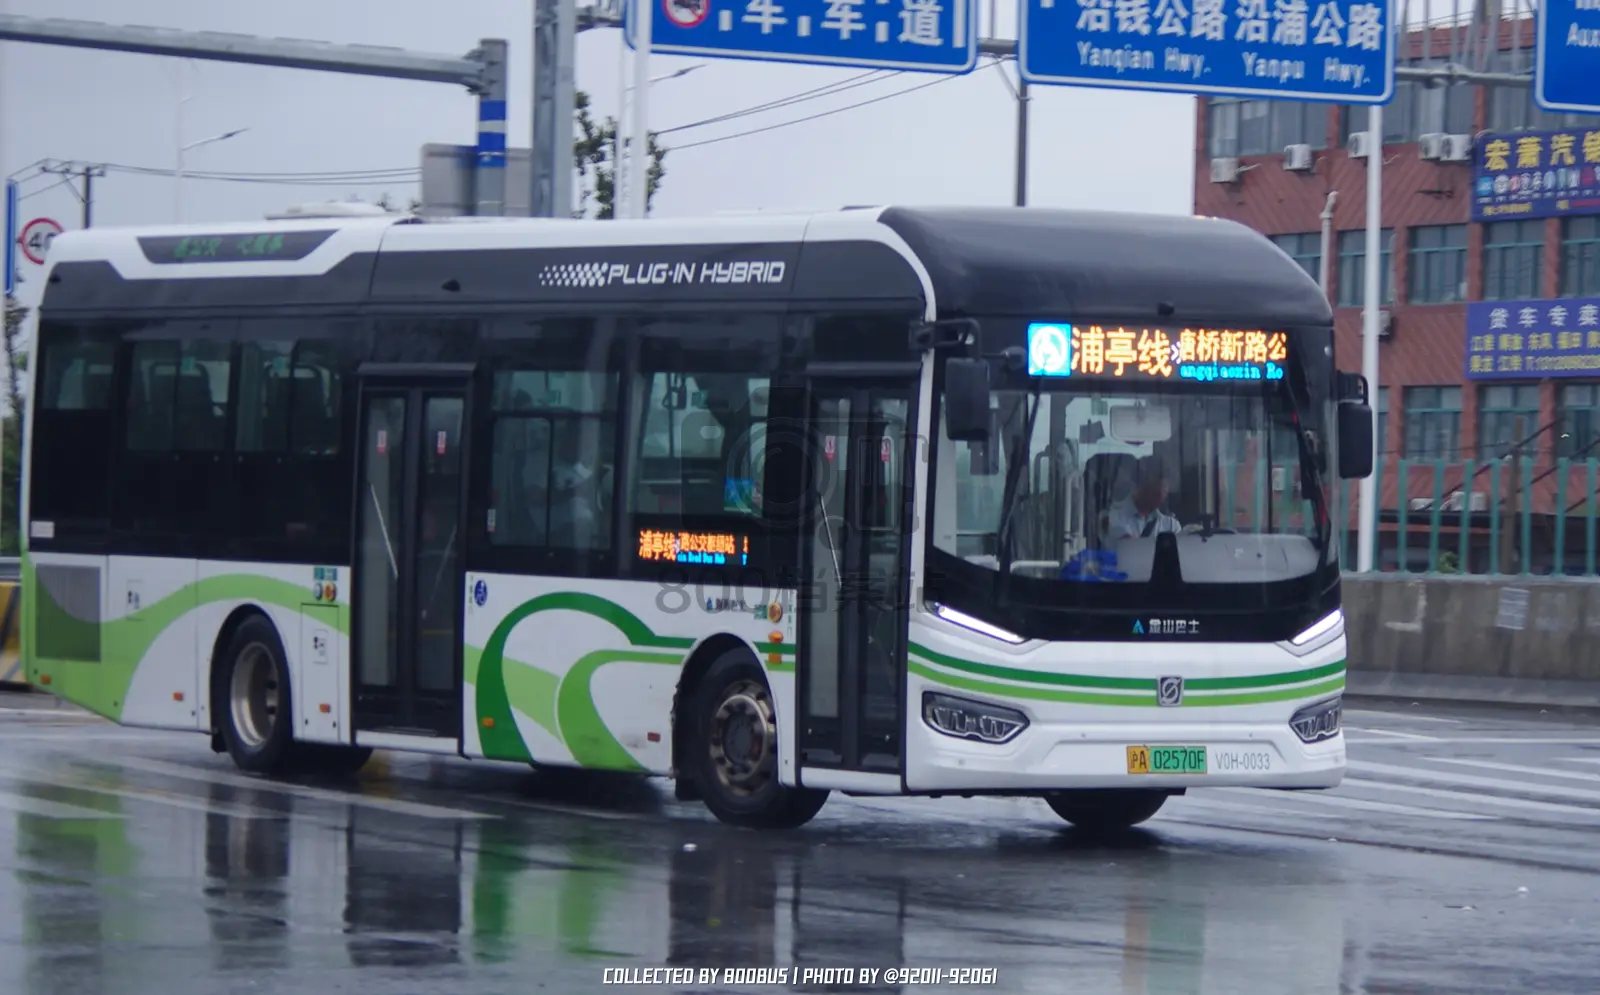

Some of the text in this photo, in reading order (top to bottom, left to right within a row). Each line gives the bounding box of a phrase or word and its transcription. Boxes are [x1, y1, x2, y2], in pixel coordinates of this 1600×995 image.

[1077, 41, 1371, 89] Yanqian Hwy. Yanpu Hwy.
[700, 261, 786, 284] HYBRID
[1071, 326, 1173, 378] 浦亭线
